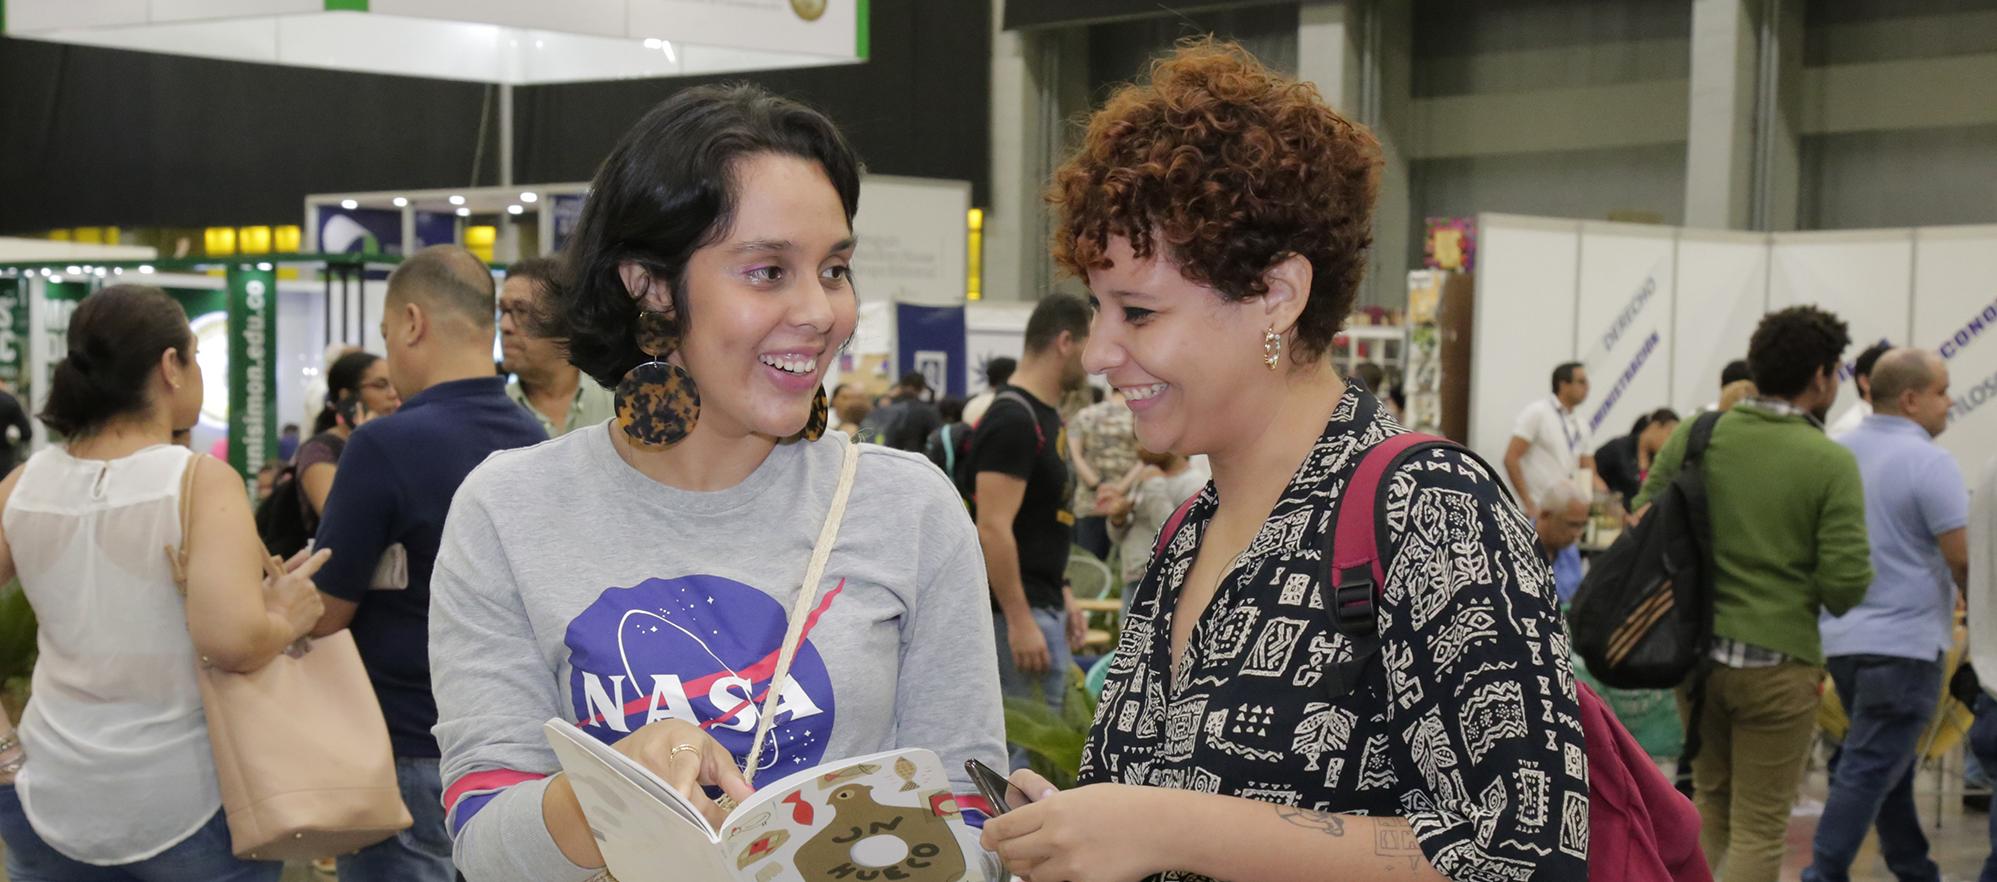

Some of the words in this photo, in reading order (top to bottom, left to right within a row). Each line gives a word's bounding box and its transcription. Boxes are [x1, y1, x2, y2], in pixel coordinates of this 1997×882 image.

[1603, 275, 1656, 351] DERECHO
[581, 671, 824, 733] NASA
[826, 842, 941, 881] HUECO
